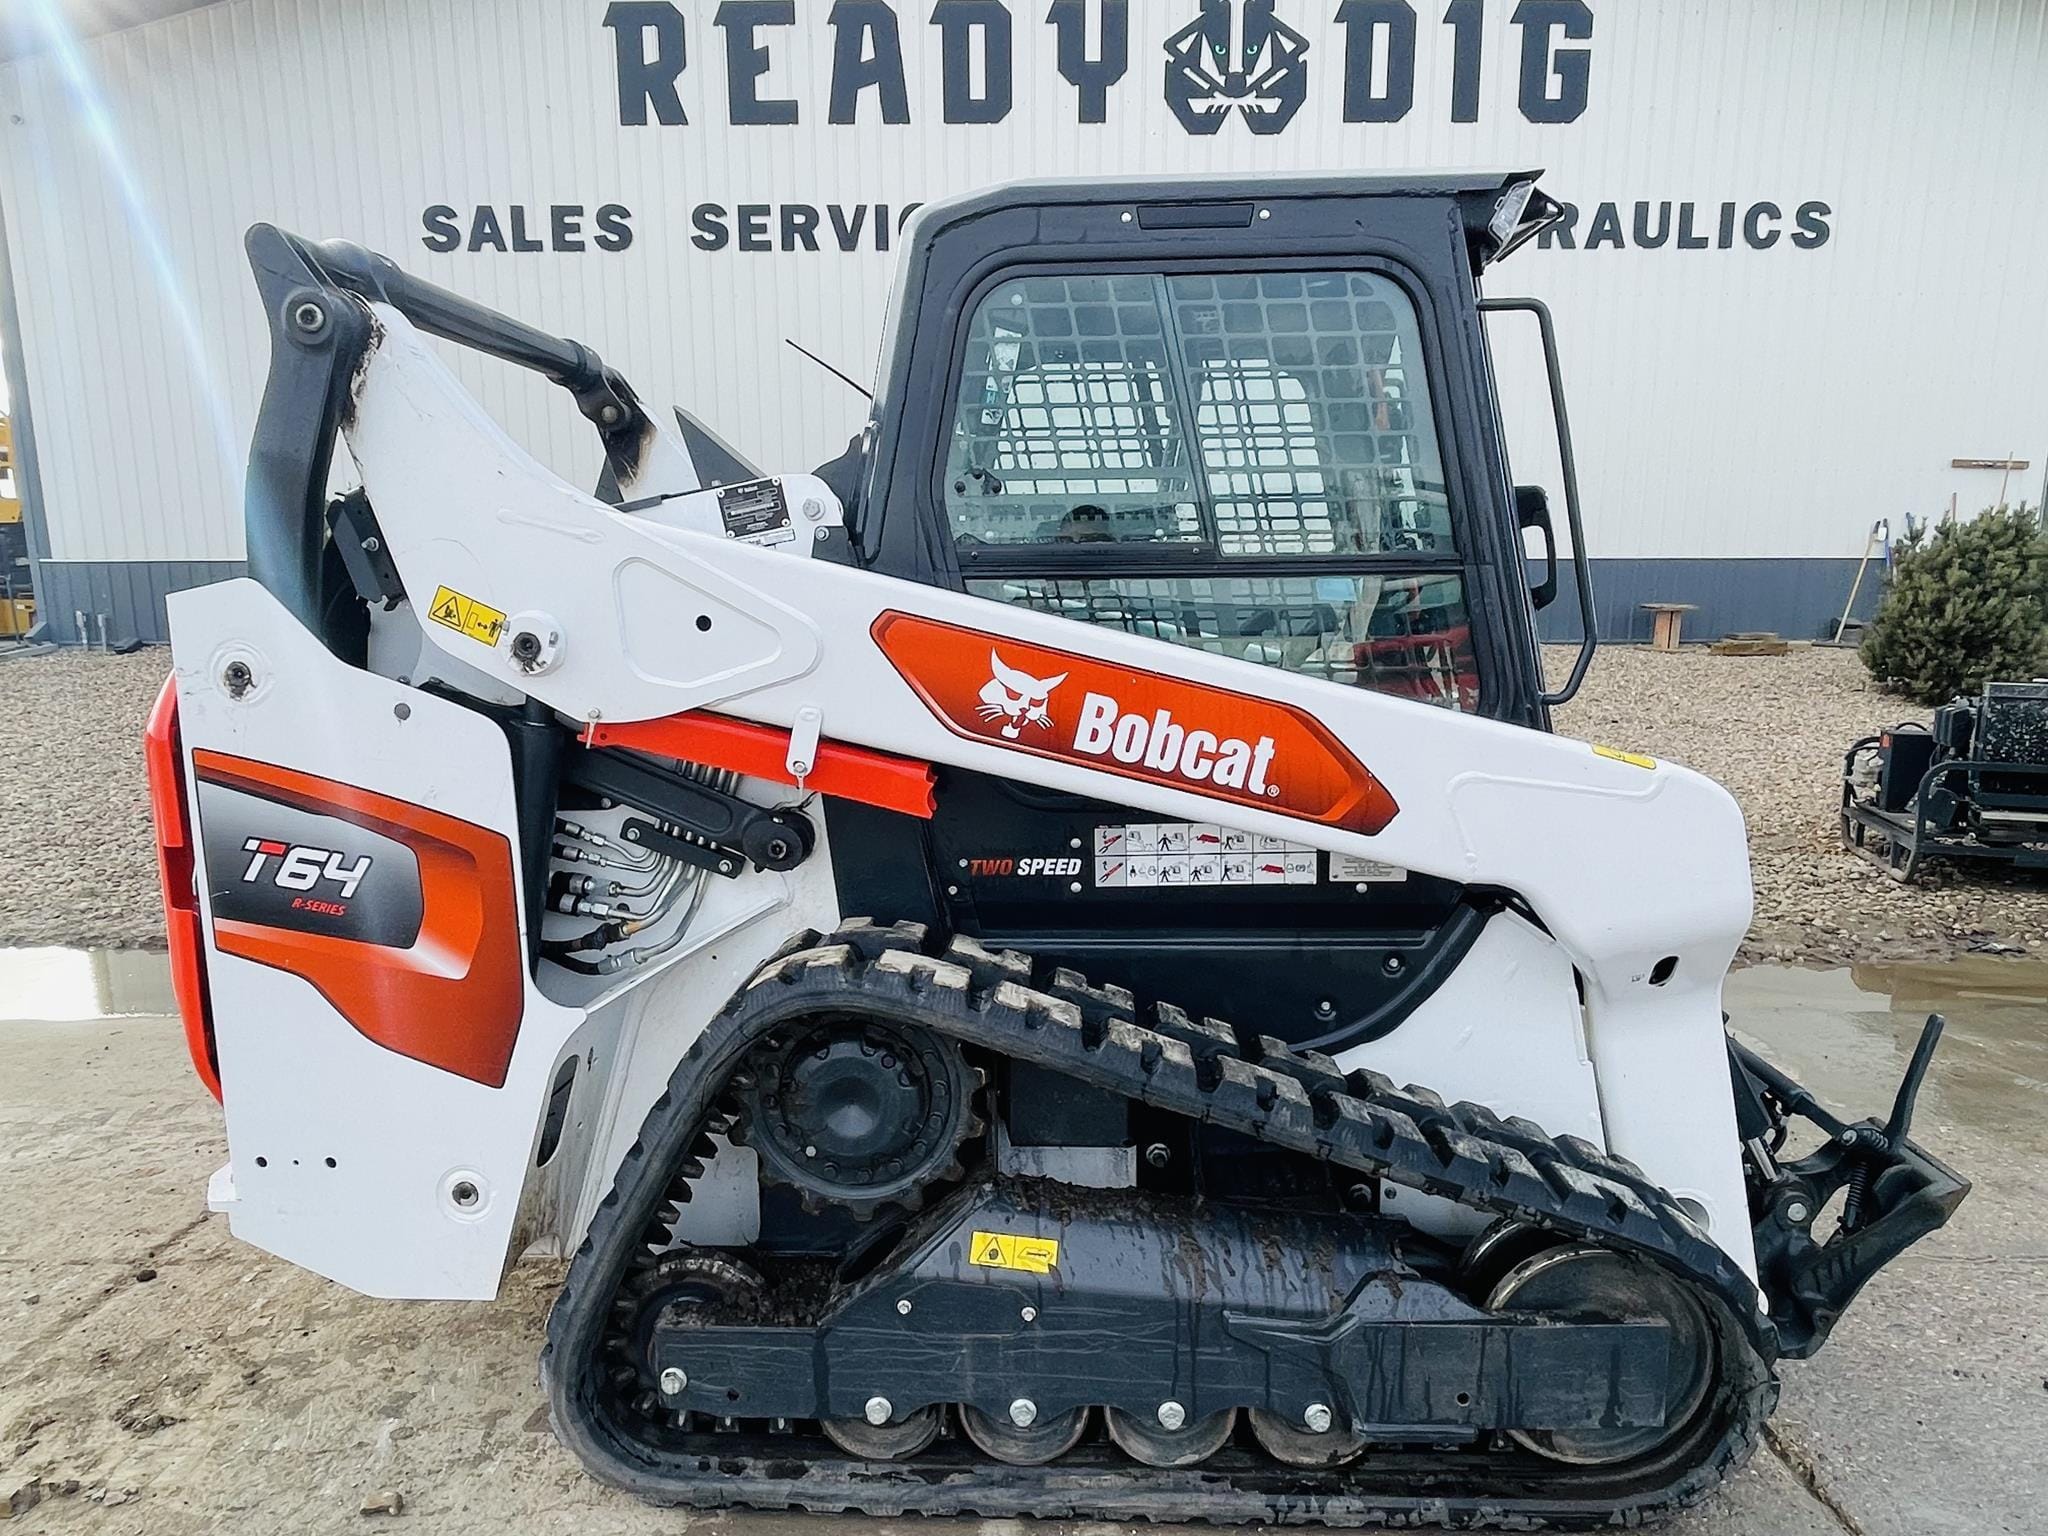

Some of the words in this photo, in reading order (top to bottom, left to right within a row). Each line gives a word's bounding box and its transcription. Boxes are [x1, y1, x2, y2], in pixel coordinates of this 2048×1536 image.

[602, 0, 1128, 126] READY
[1334, 0, 1594, 125] DIG
[422, 204, 633, 253] SALES
[691, 203, 924, 252] SERVI
[243, 837, 373, 899] T64
[970, 858, 1013, 876] TWO
[1016, 858, 1082, 876] SPEED
[291, 897, 347, 916] R-SERIES
